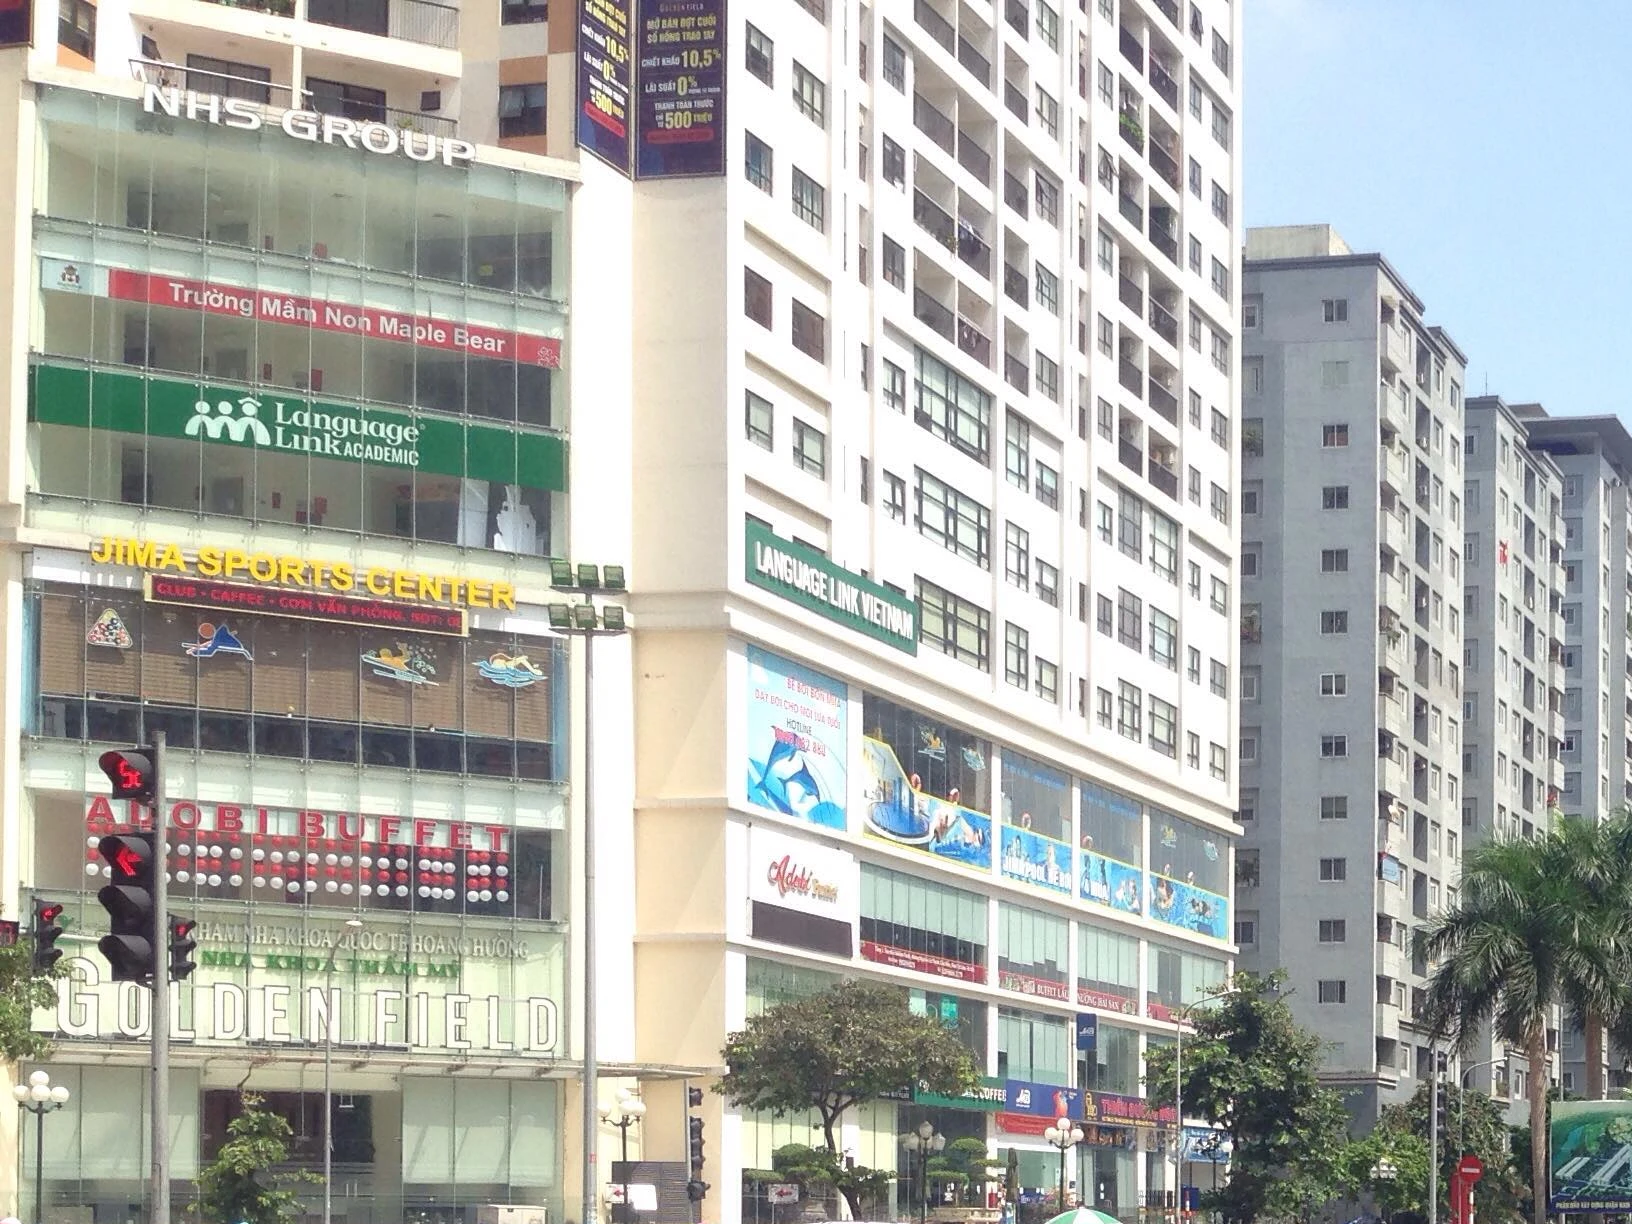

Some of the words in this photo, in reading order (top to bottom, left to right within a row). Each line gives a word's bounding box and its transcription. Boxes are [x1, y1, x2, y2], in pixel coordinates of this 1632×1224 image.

[143, 83, 262, 130] NHS
[281, 108, 477, 167] GROUP
[665, 111, 692, 129] 500
[169, 282, 253, 317] Trường
[261, 296, 317, 323] Mầm
[325, 306, 371, 331] Non
[379, 315, 447, 344] Maple
[452, 328, 506, 353] Bear
[275, 402, 420, 445] Language
[274, 426, 342, 456] Link
[342, 442, 420, 467] ACADEMIC
[92, 536, 187, 573] JIMA
[196, 546, 355, 593] SPORTS
[366, 565, 517, 613] CENTER
[156, 583, 197, 599] CLUB
[756, 541, 828, 601] LANGUAGE
[830, 577, 860, 617] LINK
[860, 591, 914, 641] VIETNAM
[297, 811, 510, 853] BUFFET
[57, 957, 341, 1045] GOLDEN
[374, 990, 559, 1051] FIELD
[979, 1087, 1007, 1102] COFFEE
